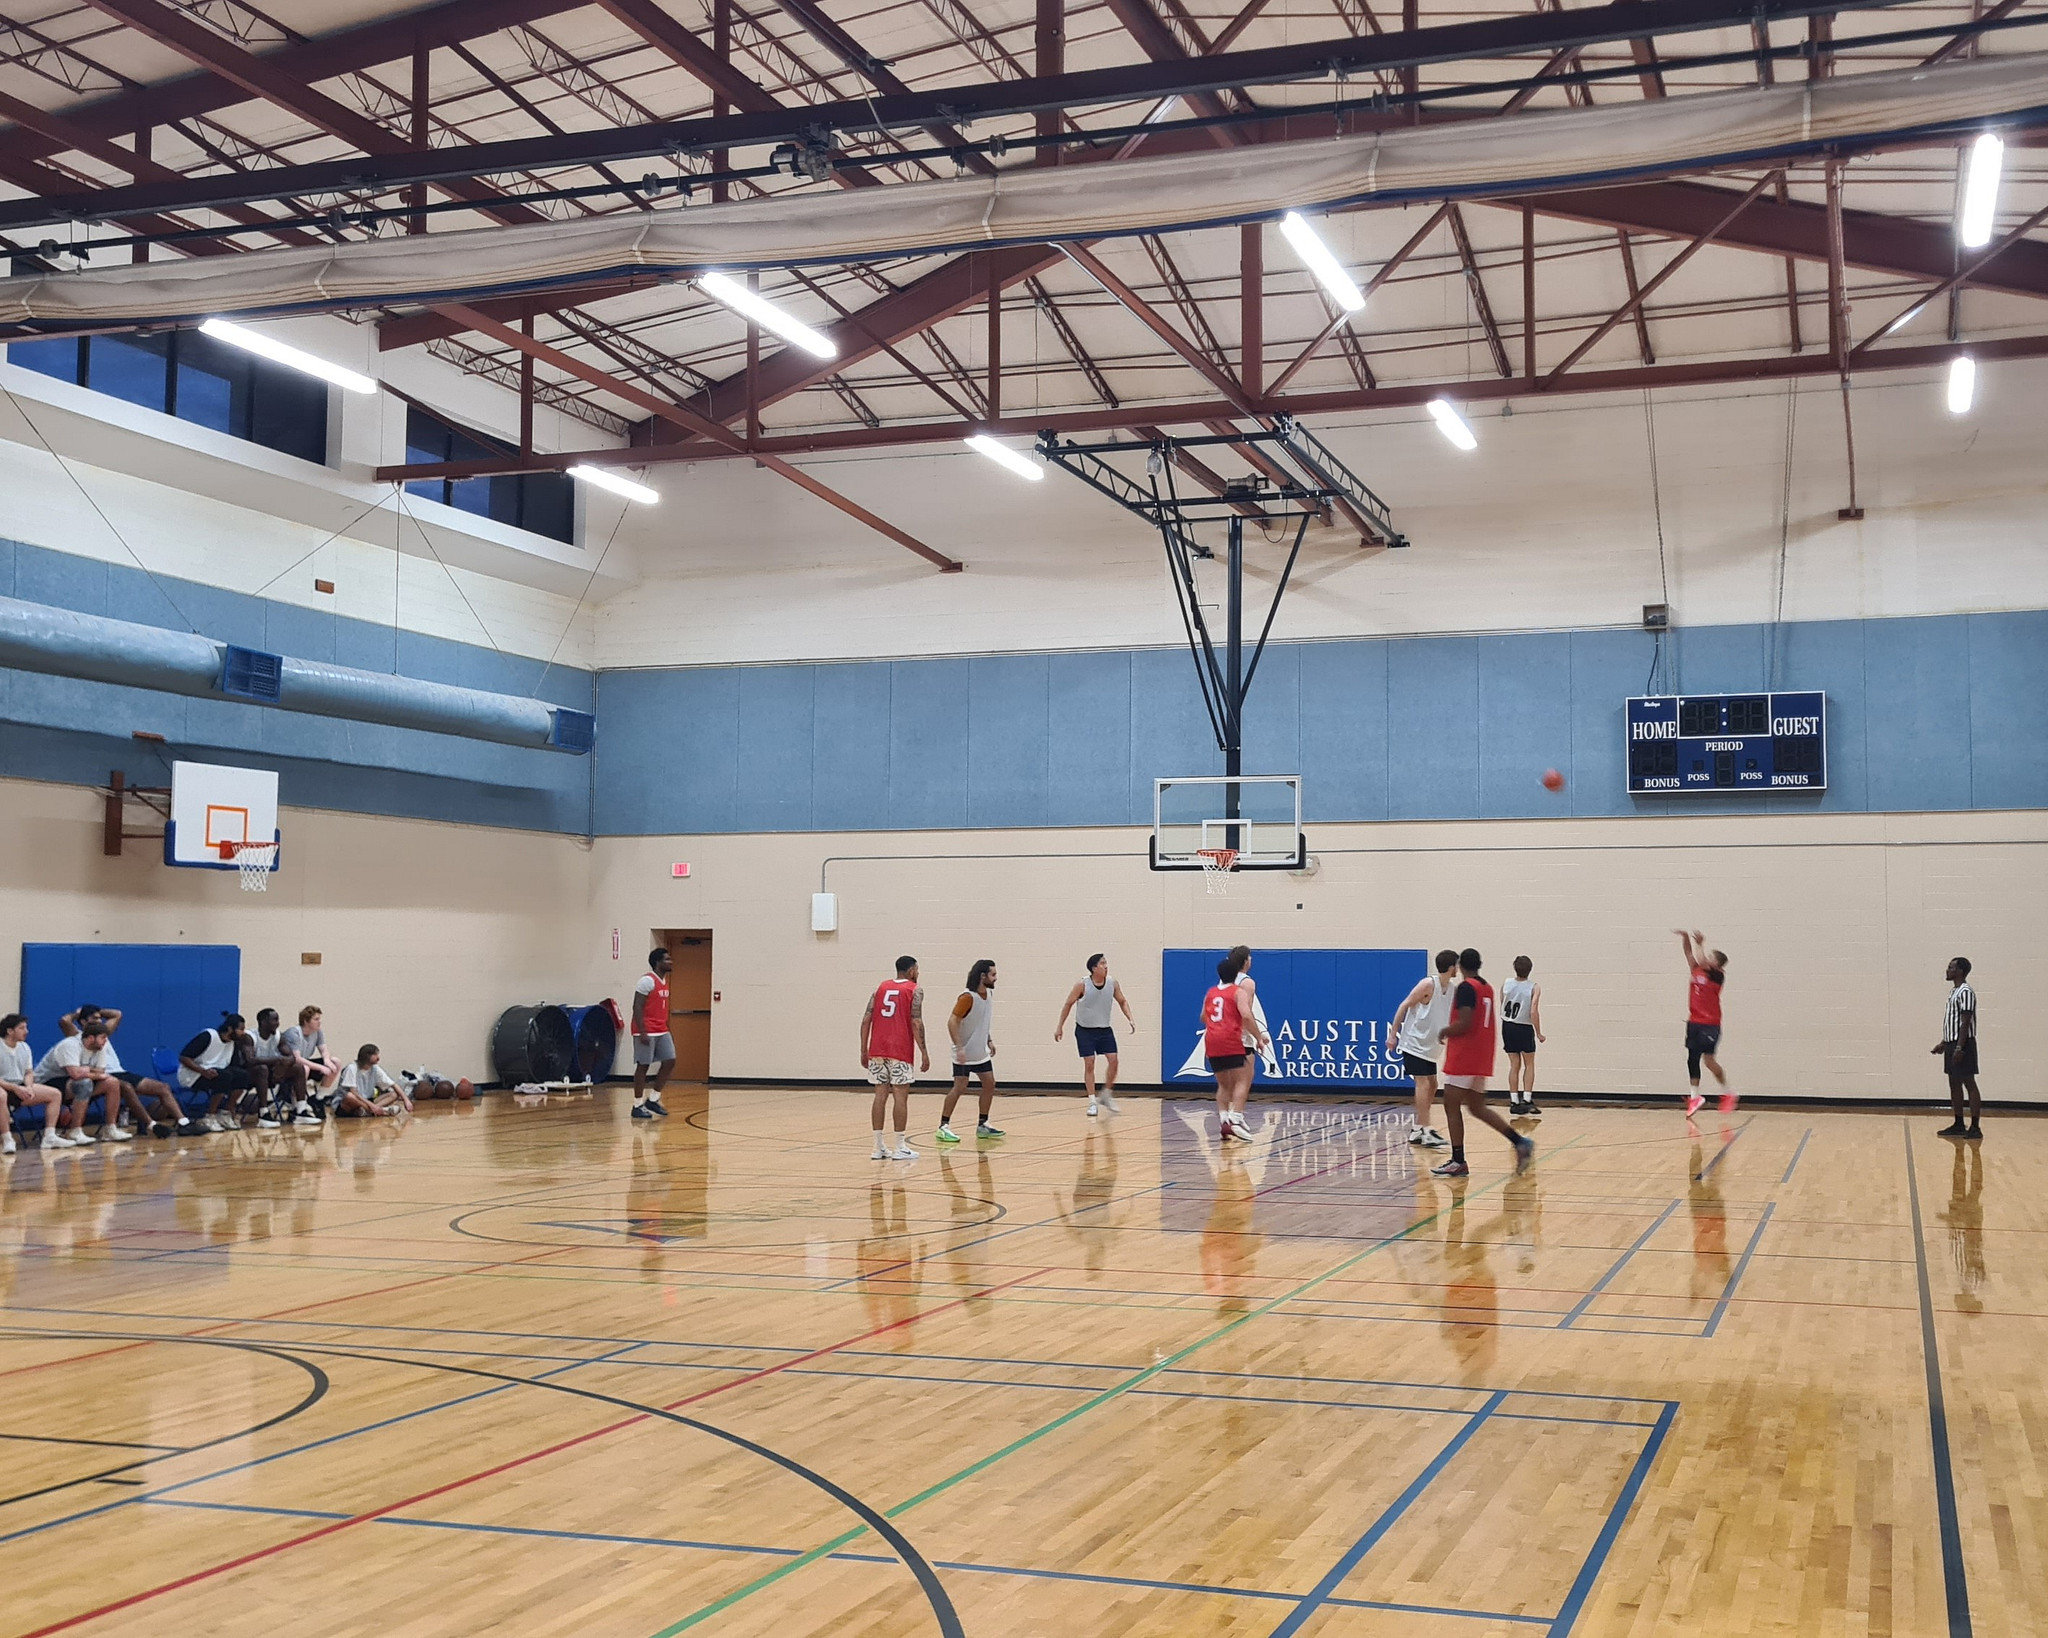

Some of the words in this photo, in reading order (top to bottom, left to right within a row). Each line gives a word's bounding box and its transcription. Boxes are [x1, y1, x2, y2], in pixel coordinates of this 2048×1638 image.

[1632, 721, 1676, 740] HOME
[1773, 717, 1819, 736] GUEST
[1705, 741, 1743, 752] PERIOD
[1644, 778, 1680, 788] BONUS
[1687, 773, 1710, 781] POSS
[1740, 772, 1763, 780] POSS
[1771, 775, 1808, 785] BONUS
[881, 990, 900, 1018] 5
[1210, 996, 1224, 1022] 3
[1504, 1000, 1520, 1019] 40
